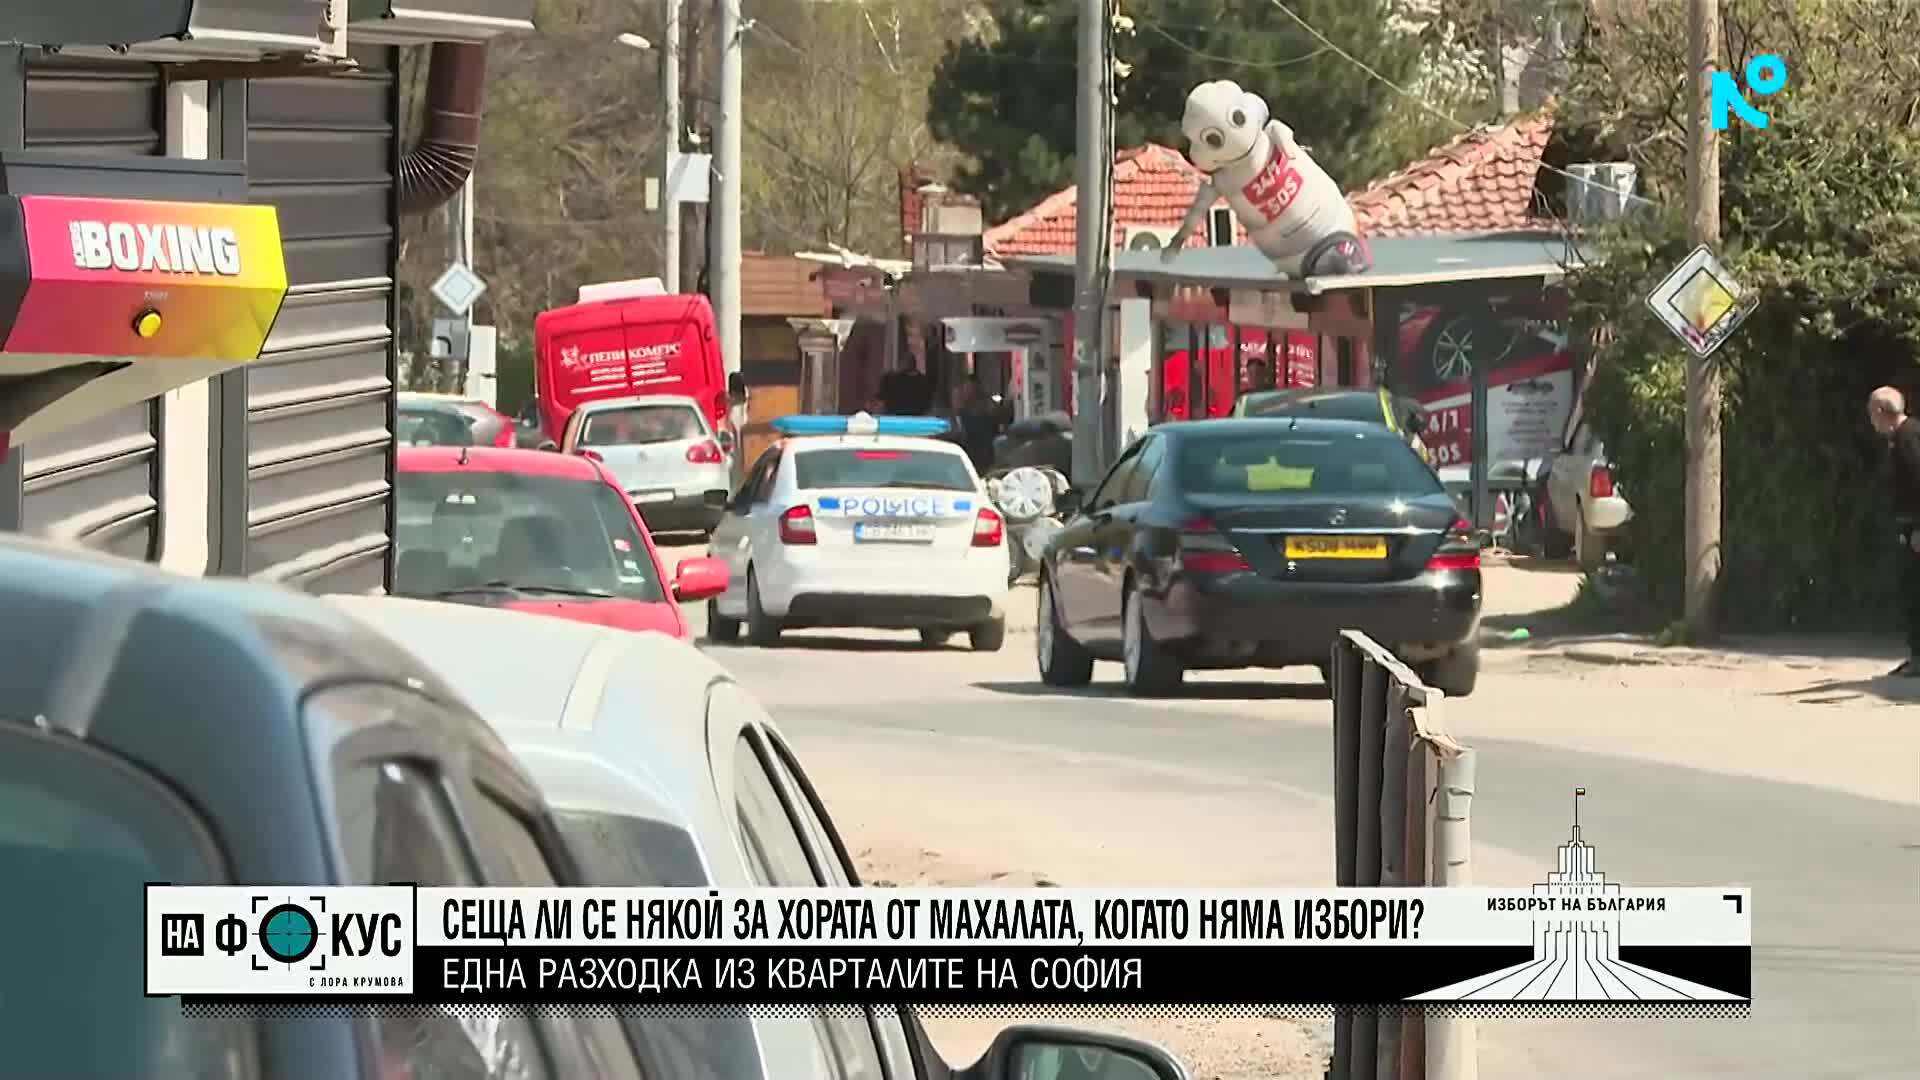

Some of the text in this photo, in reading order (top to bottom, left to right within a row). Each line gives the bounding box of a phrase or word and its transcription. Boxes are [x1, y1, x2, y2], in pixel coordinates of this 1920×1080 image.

[1267, 176, 1298, 215] SOS
[80, 221, 241, 275] BOXING
[1429, 443, 1461, 464] SOS
[844, 498, 944, 516] POLICE
